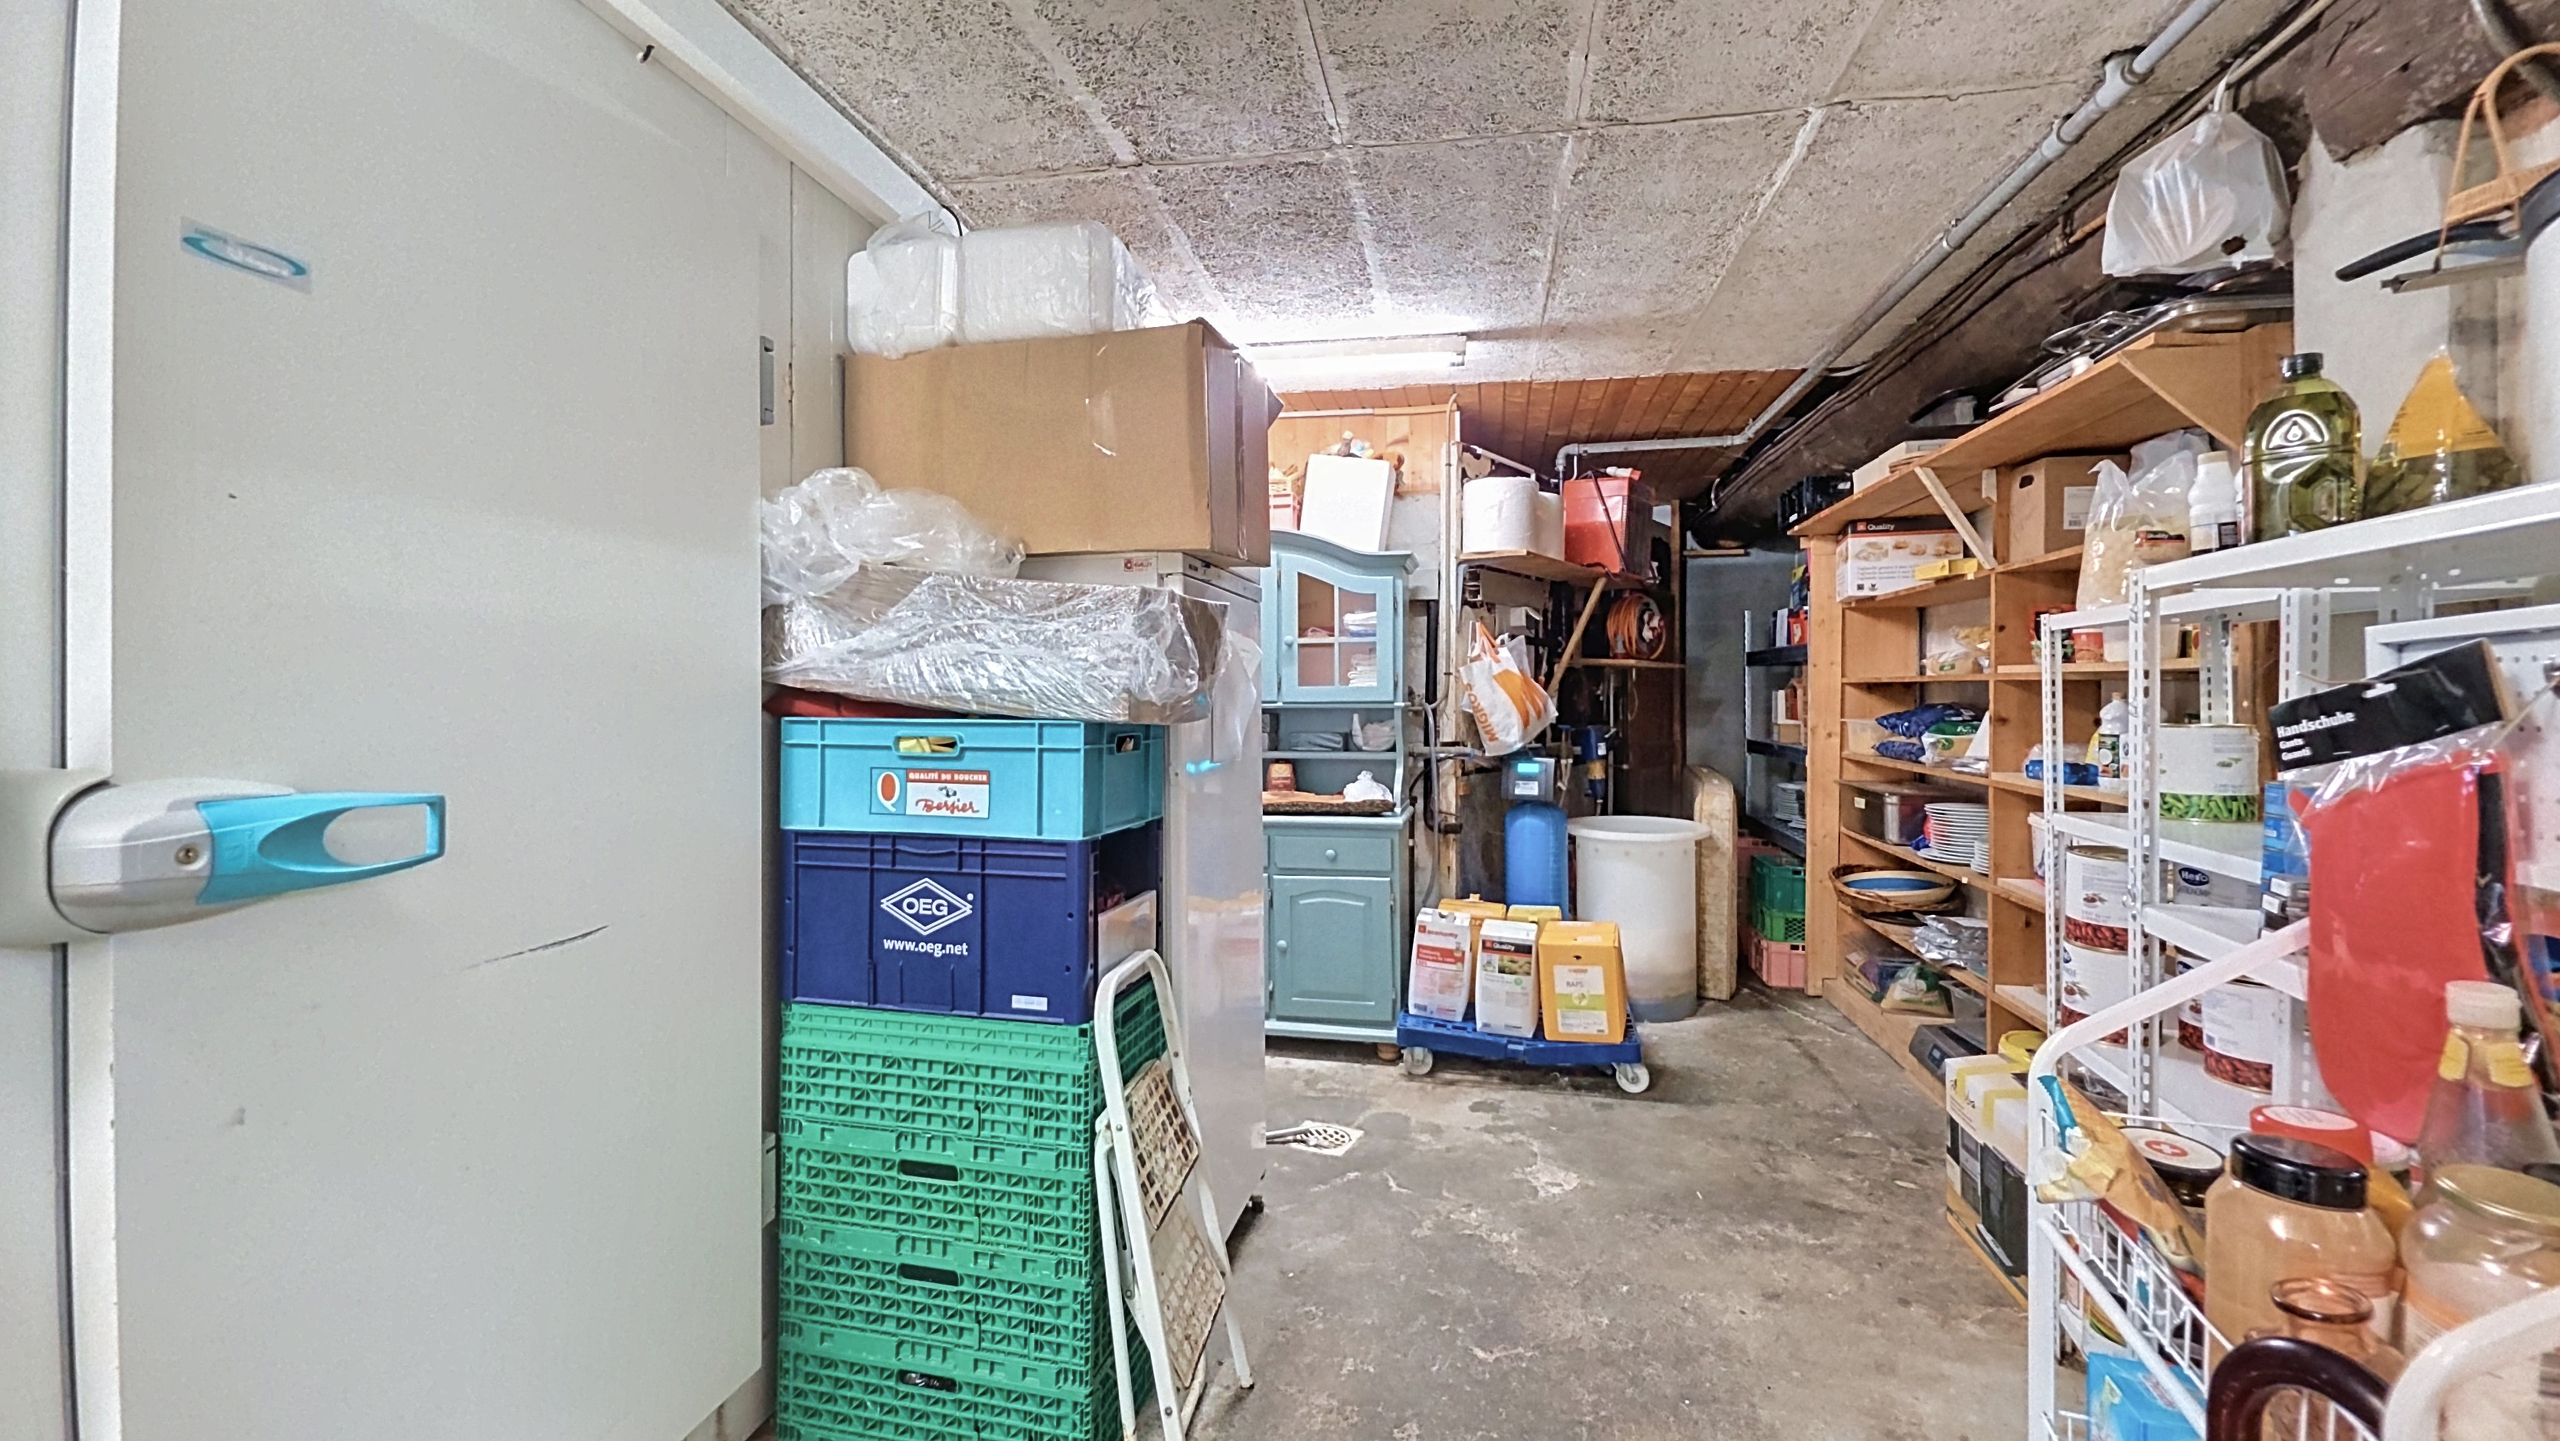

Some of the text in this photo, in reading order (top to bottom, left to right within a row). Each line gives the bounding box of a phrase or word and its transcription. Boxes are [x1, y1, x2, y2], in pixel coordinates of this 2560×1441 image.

[1867, 523, 1895, 531] Quality
[2276, 711, 2356, 738] Handschuhe
[909, 771, 987, 782] QUALITÉ DU BOUCHER
[902, 897, 948, 916] OEG
[883, 939, 968, 958] www.oeg.net
[1493, 942, 1515, 952] Quality
